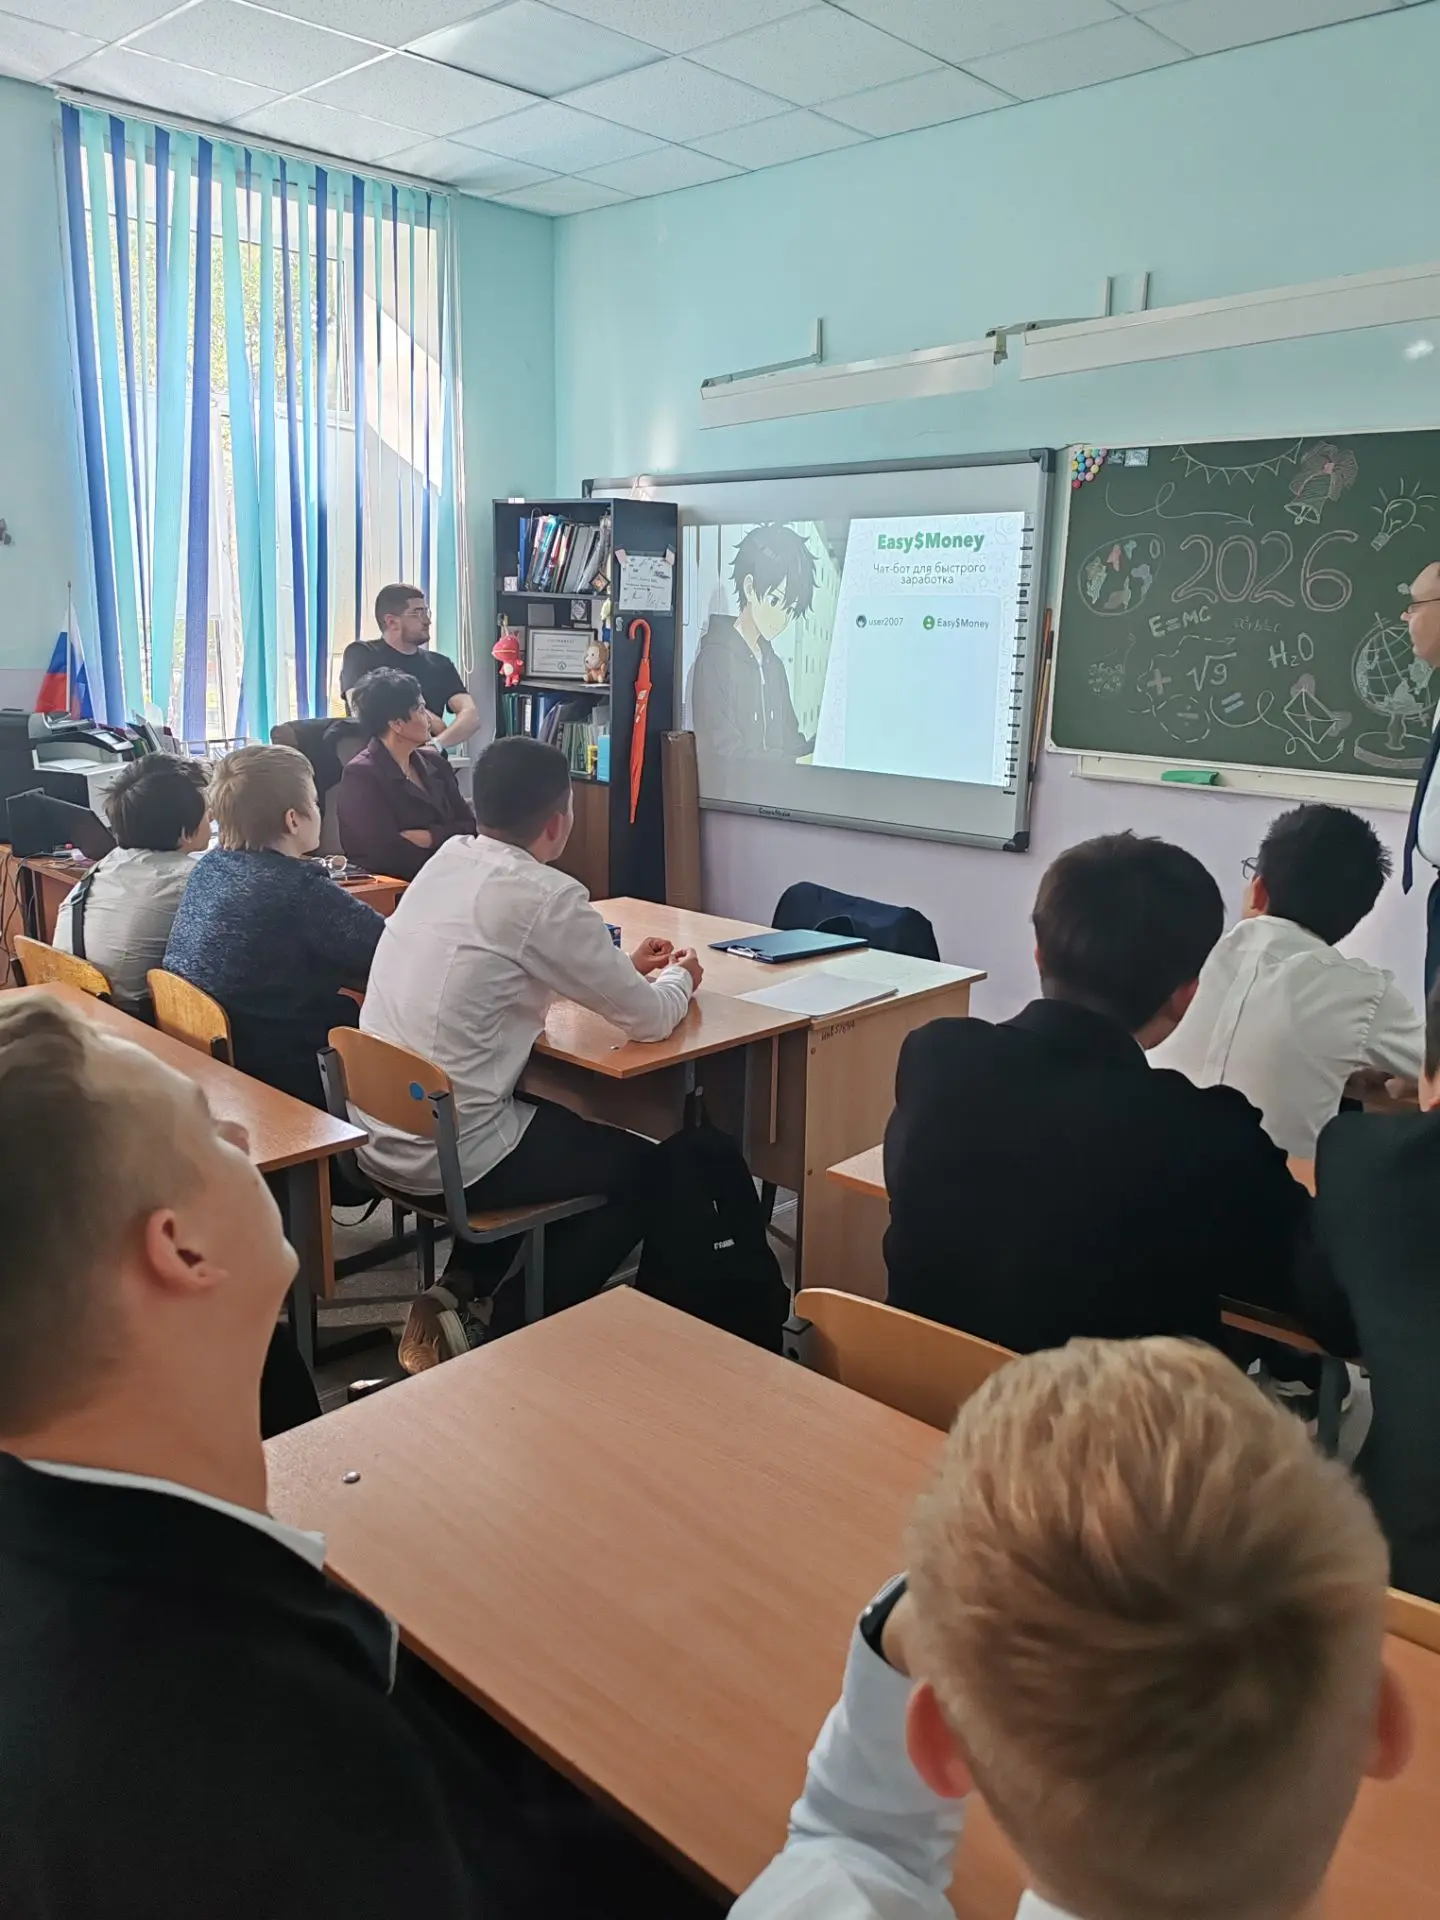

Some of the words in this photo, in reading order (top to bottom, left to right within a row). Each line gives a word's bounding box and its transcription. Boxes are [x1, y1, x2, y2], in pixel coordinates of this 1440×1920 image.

[877, 532, 985, 554] Easy$Money
[873, 562, 910, 574] Чат-бот
[912, 565, 931, 575] для
[935, 562, 986, 576] быстрого
[1171, 529, 1359, 612] 2026
[900, 574, 954, 585] заработка
[868, 617, 904, 627] user2007
[937, 617, 989, 629] Easy$Money
